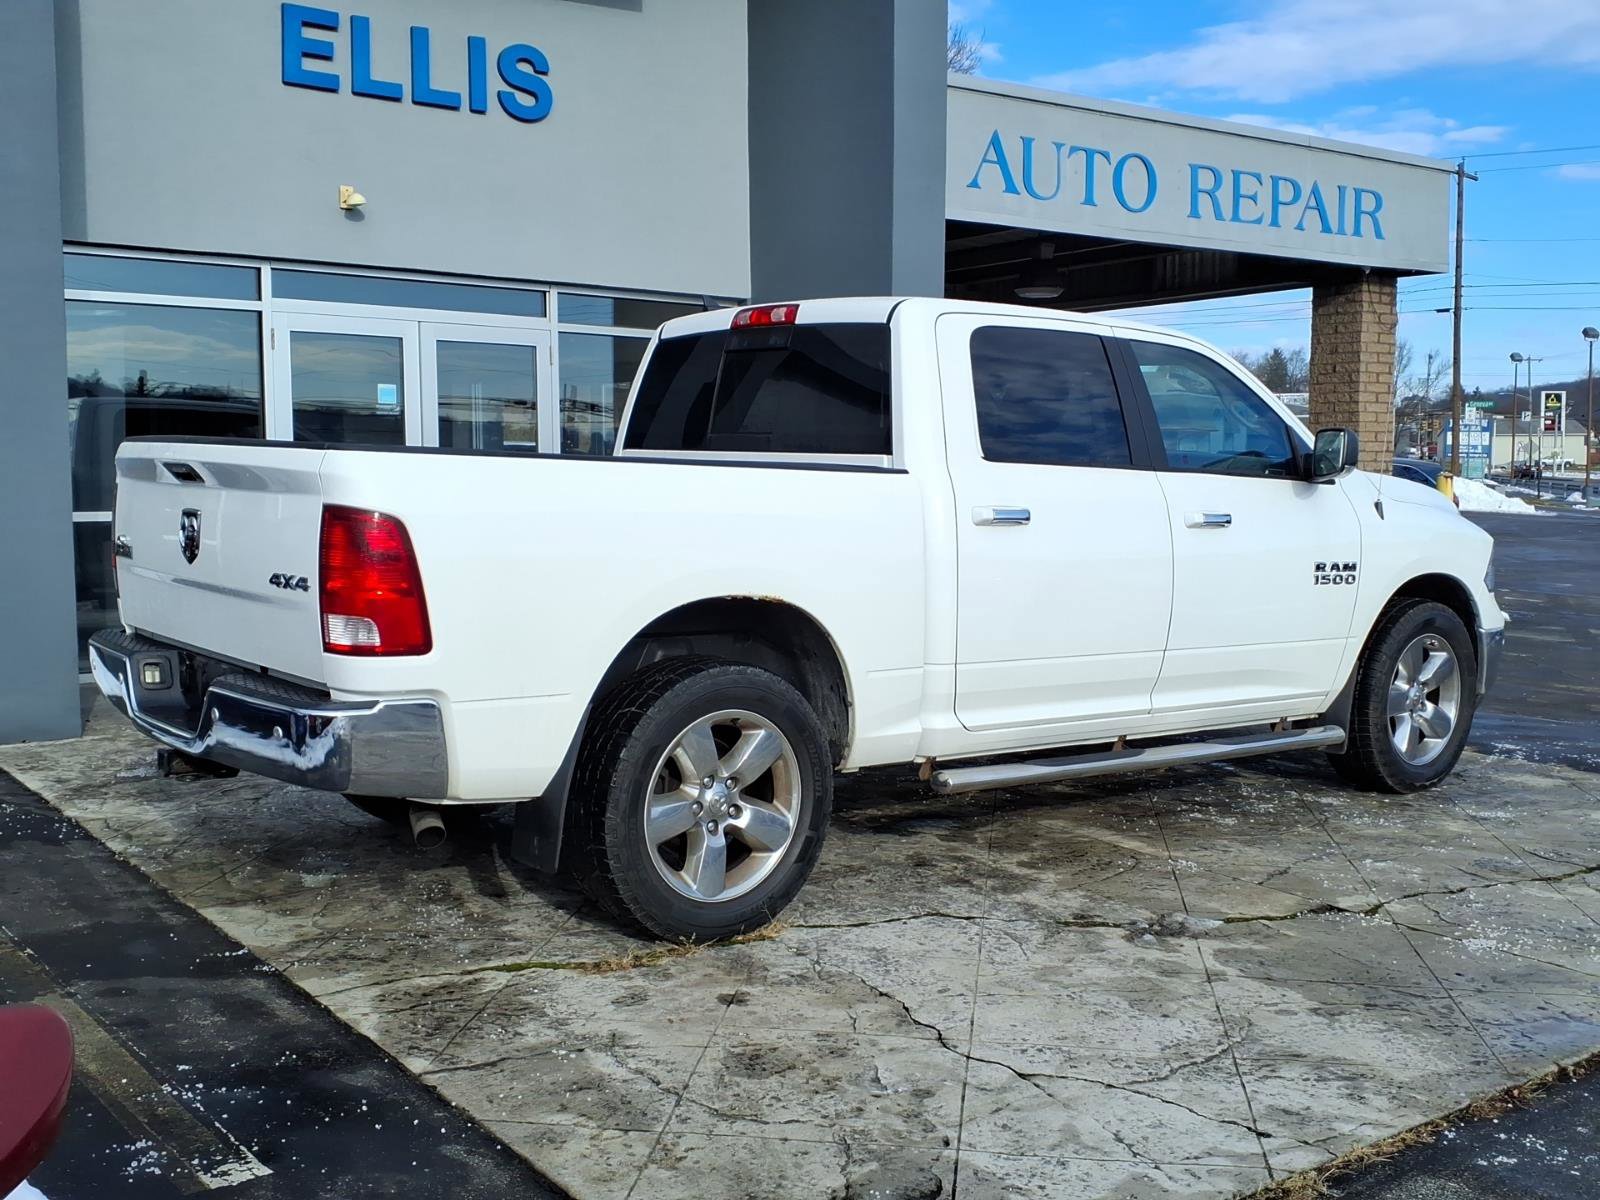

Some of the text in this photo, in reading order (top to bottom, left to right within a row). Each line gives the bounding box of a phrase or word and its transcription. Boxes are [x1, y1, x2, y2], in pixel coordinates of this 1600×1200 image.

[281, 2, 553, 123] ELLIS
[966, 129, 1386, 240] AUTO REPAIR
[1313, 561, 1357, 573] RAM
[1313, 574, 1356, 585] 1500
